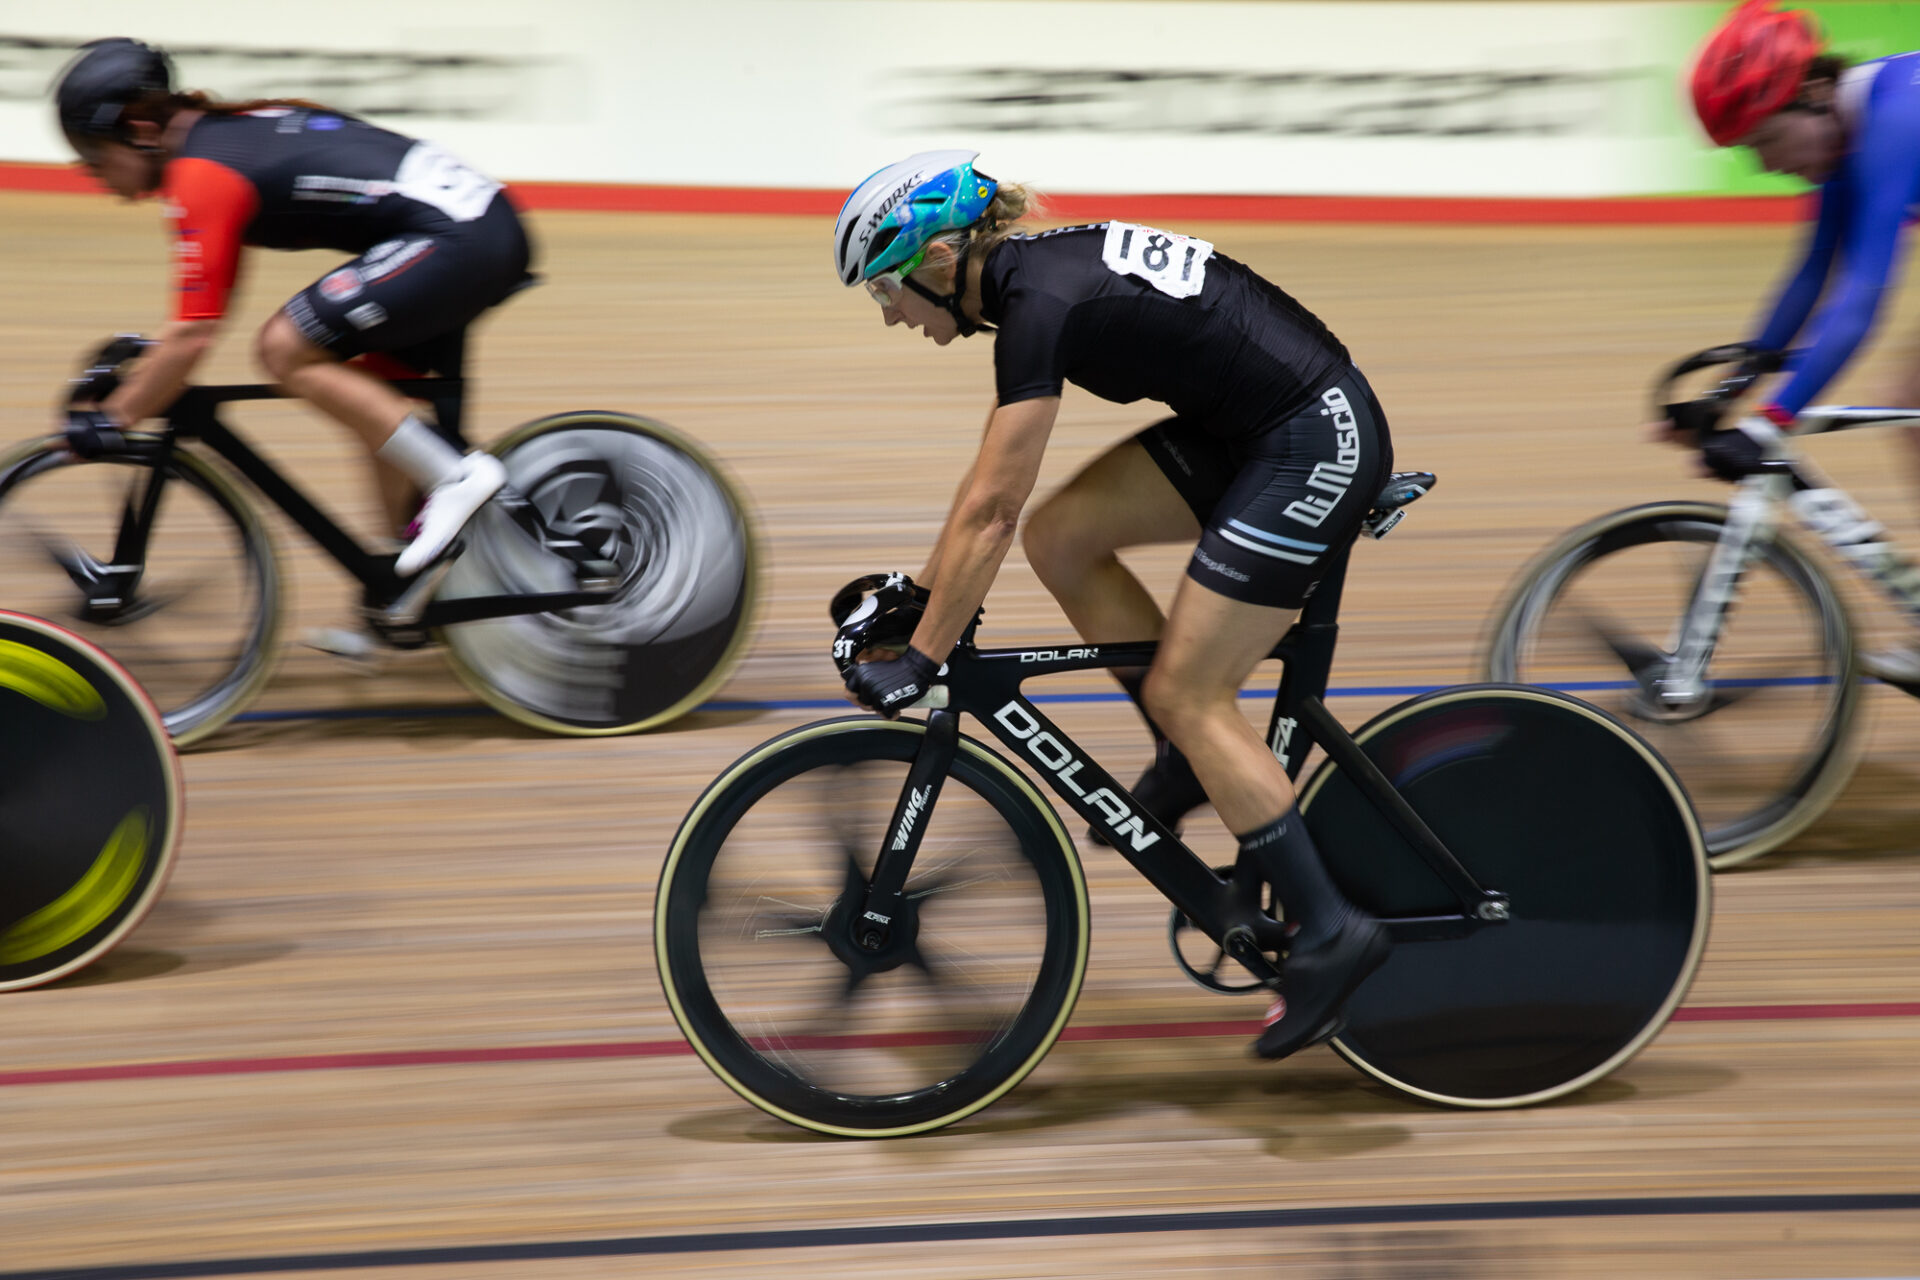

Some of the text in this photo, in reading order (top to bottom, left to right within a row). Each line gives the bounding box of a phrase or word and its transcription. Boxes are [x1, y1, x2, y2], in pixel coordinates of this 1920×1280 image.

[859, 170, 924, 249] S-WORKS
[1119, 229, 1197, 281] 181
[833, 639, 854, 659] 3T
[1020, 648, 1099, 663] DOLAN
[993, 700, 1162, 852] DOLAN
[891, 787, 923, 851] WING
